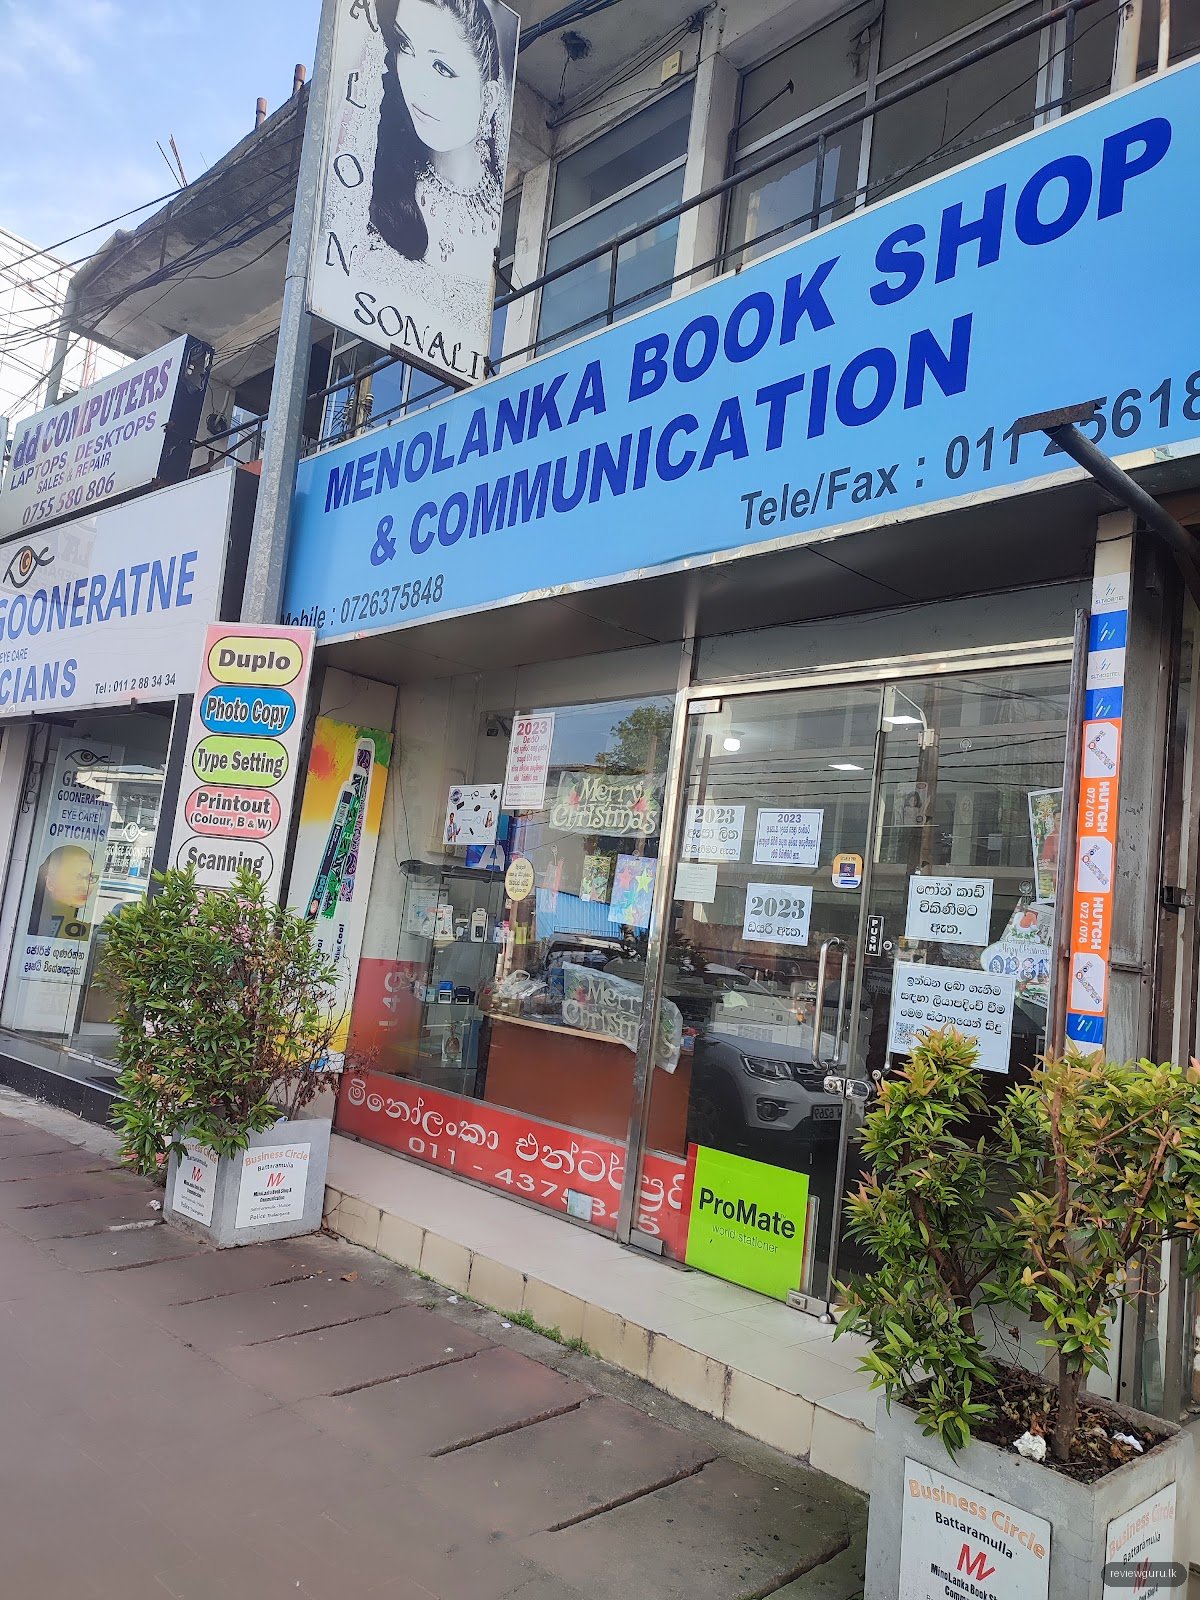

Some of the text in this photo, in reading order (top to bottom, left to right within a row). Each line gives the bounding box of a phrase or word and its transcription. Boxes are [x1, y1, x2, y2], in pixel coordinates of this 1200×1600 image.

[324, 117, 1172, 513] MENOLANKA BOOK SHOP
[353, 291, 481, 380] SONALI
[42, 357, 173, 455] COMPUTERS
[10, 410, 157, 491] LAPTOPS DESKTOPS
[370, 312, 973, 567] & COMMUNICATION
[36, 474, 65, 493] SALES
[75, 451, 112, 479] REPAIR
[22, 472, 115, 526] 0755 580 806
[741, 462, 899, 529] Tele/Fax
[280, 605, 326, 629] Mobile
[340, 573, 445, 624] 0726375848
[12, 647, 29, 662] CARE
[218, 648, 291, 673] Duplo
[95, 682, 107, 695] Tel
[113, 680, 129, 693] 011
[130, 679, 136, 691] 2
[138, 677, 149, 689] 88
[151, 675, 163, 688] 34
[165, 673, 176, 686] 34
[204, 697, 291, 730] Photo Copy
[516, 721, 548, 736] 2023
[197, 748, 285, 778] Type Setting
[196, 792, 271, 816] Printout
[577, 777, 646, 808] Merry
[1097, 781, 1111, 833] HUTCH
[49, 822, 107, 842] OPTICIANS
[62, 809, 100, 823] EYE CARE
[190, 814, 273, 832] (Colour, B & W)
[551, 800, 660, 835] Christmas
[694, 808, 736, 824] 2023
[777, 813, 802, 823] 2023
[186, 846, 265, 881] Scanning
[750, 896, 806, 920] 2023
[1091, 897, 1104, 950] HUTCH
[868, 919, 879, 952] PUSH
[347, 1078, 499, 1150] මිනෝලංකා
[245, 1149, 309, 1167] Business Circle
[408, 1137, 456, 1165] 011
[699, 1187, 796, 1239] ProMate
[712, 1225, 779, 1253] world stationer
[908, 1479, 1046, 1560] Business Circle
[935, 1511, 1013, 1559] Battaramulla
[1108, 1501, 1175, 1561] Business Circle
[1122, 1530, 1162, 1566] Battaramulla
[930, 1562, 969, 1592] MinoLanka
[970, 1582, 988, 1600] Book
